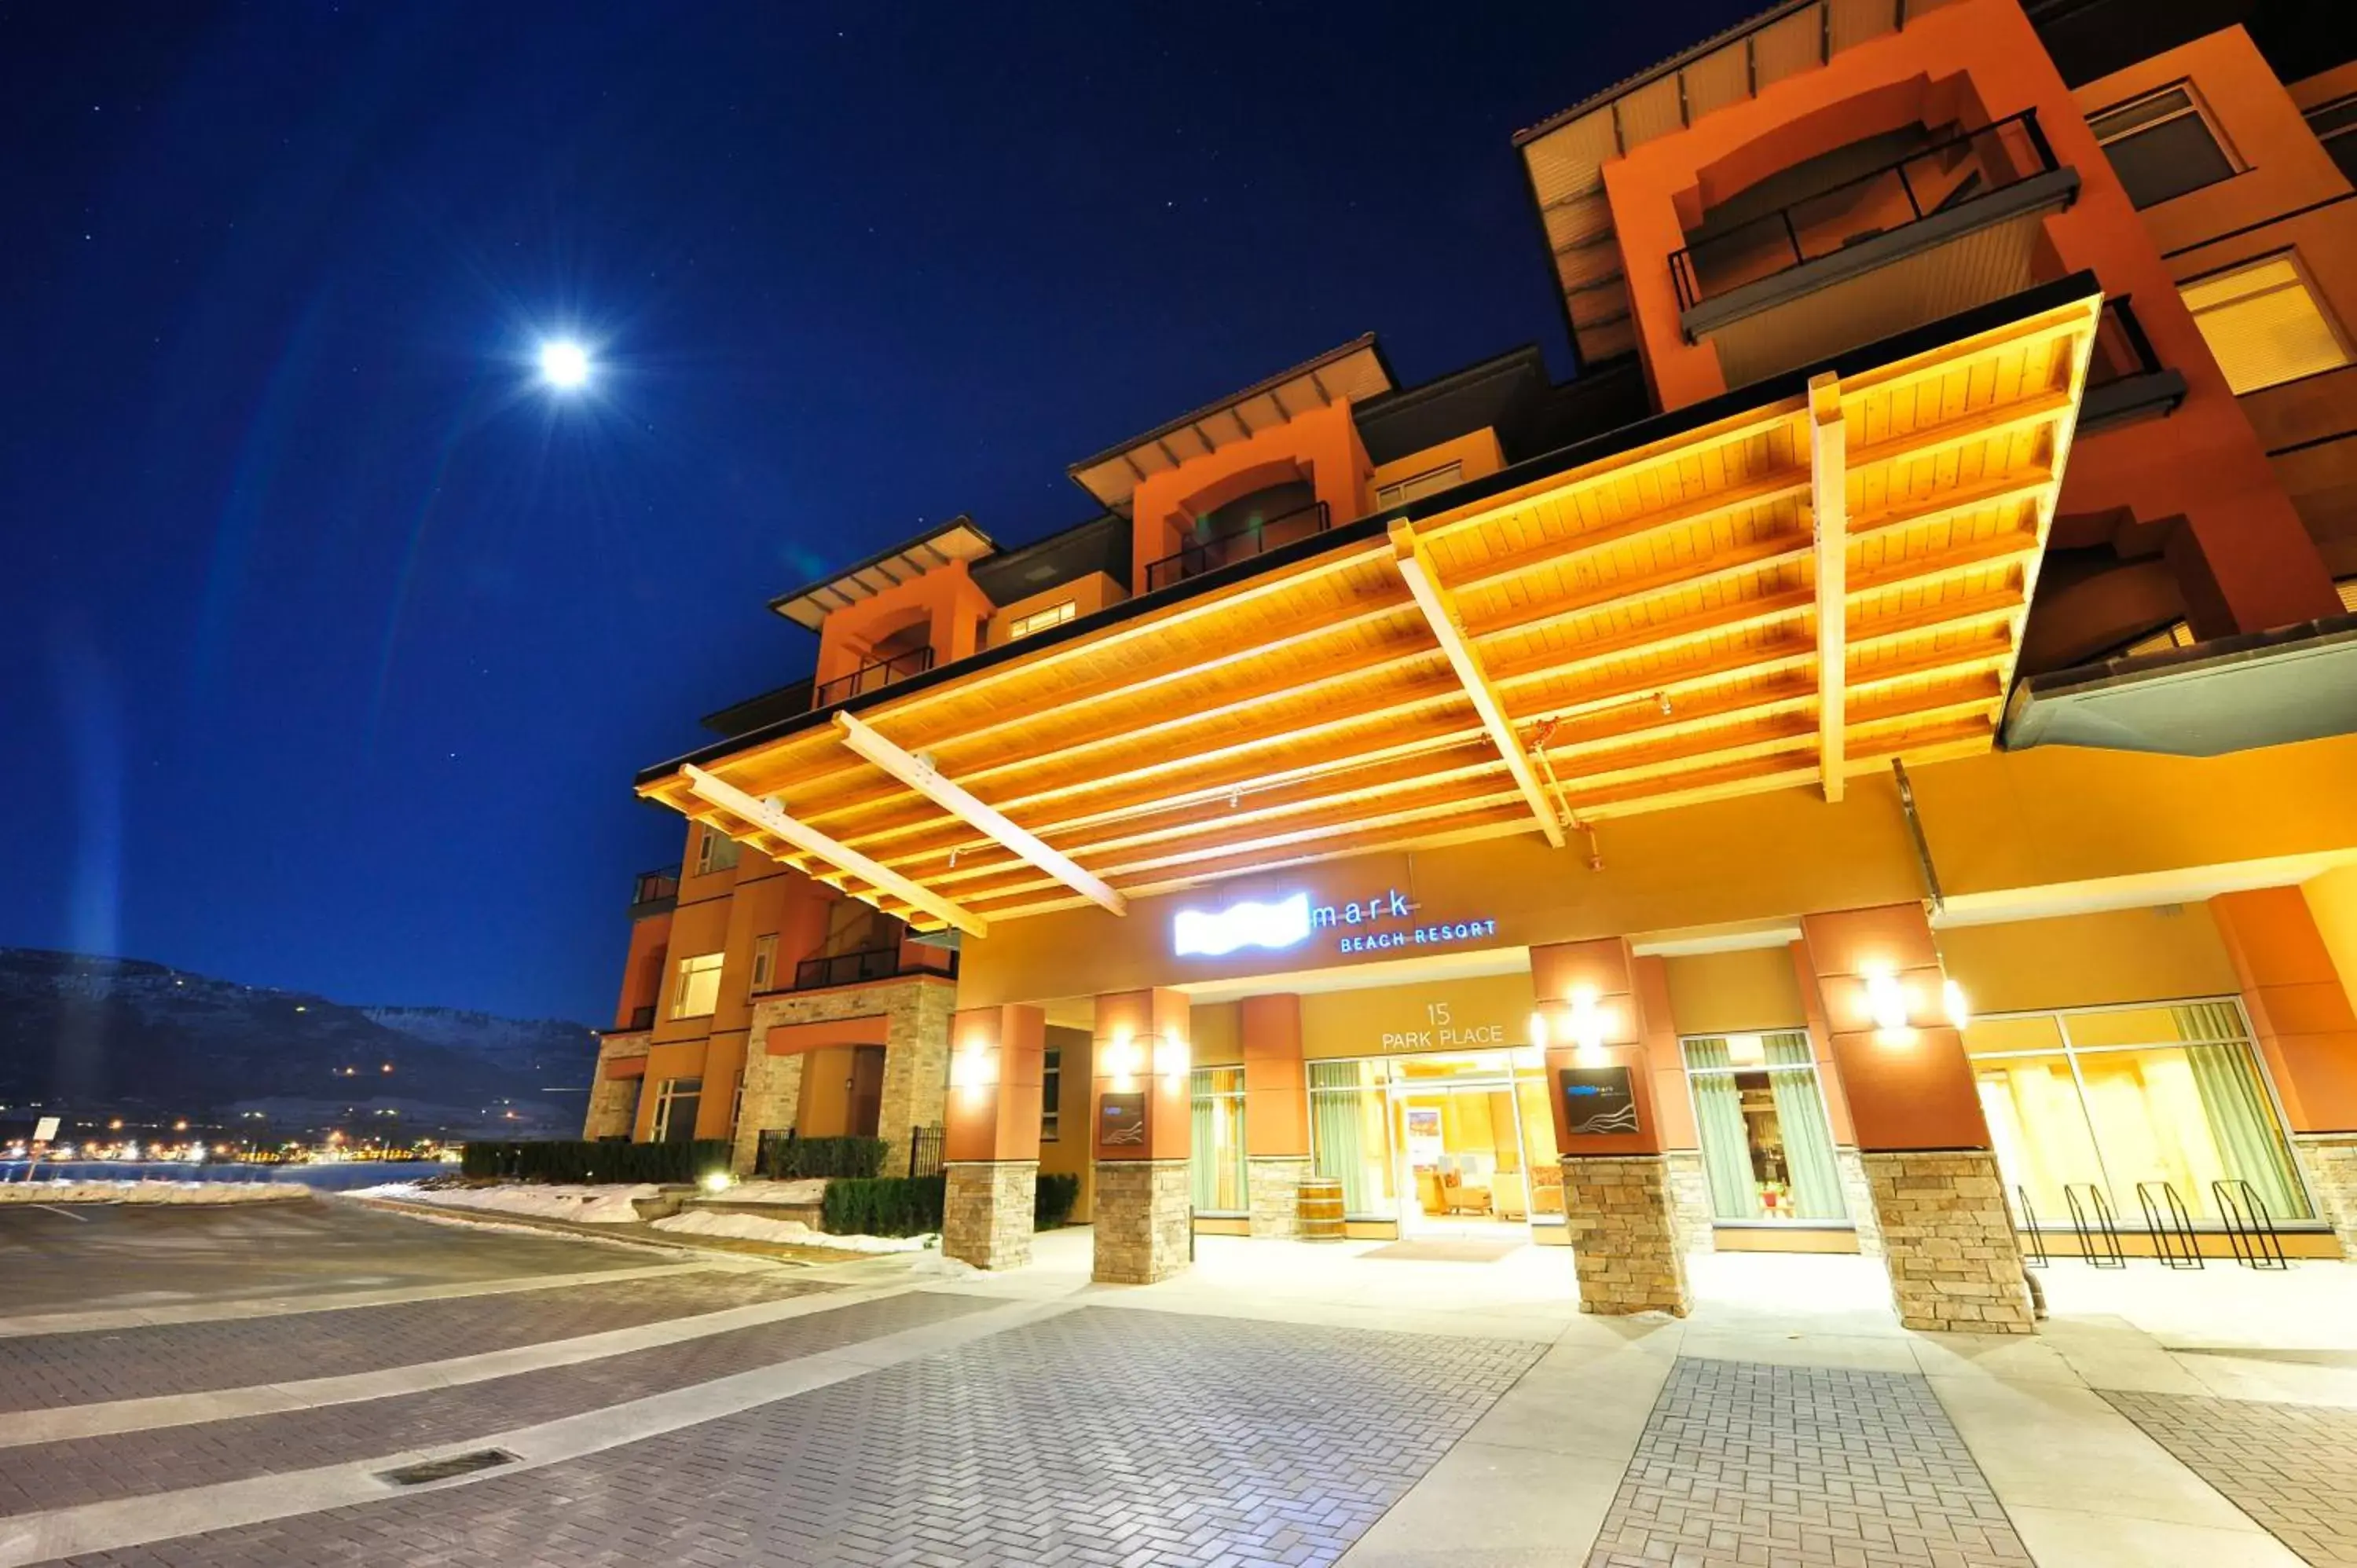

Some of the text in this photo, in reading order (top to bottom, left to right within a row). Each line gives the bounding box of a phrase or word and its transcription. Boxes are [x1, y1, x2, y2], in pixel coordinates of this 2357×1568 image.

[1341, 921, 1496, 952] BEACH RESORT
[1428, 1002, 1451, 1026] 15
[1382, 1025, 1504, 1050] PARK PLACE
